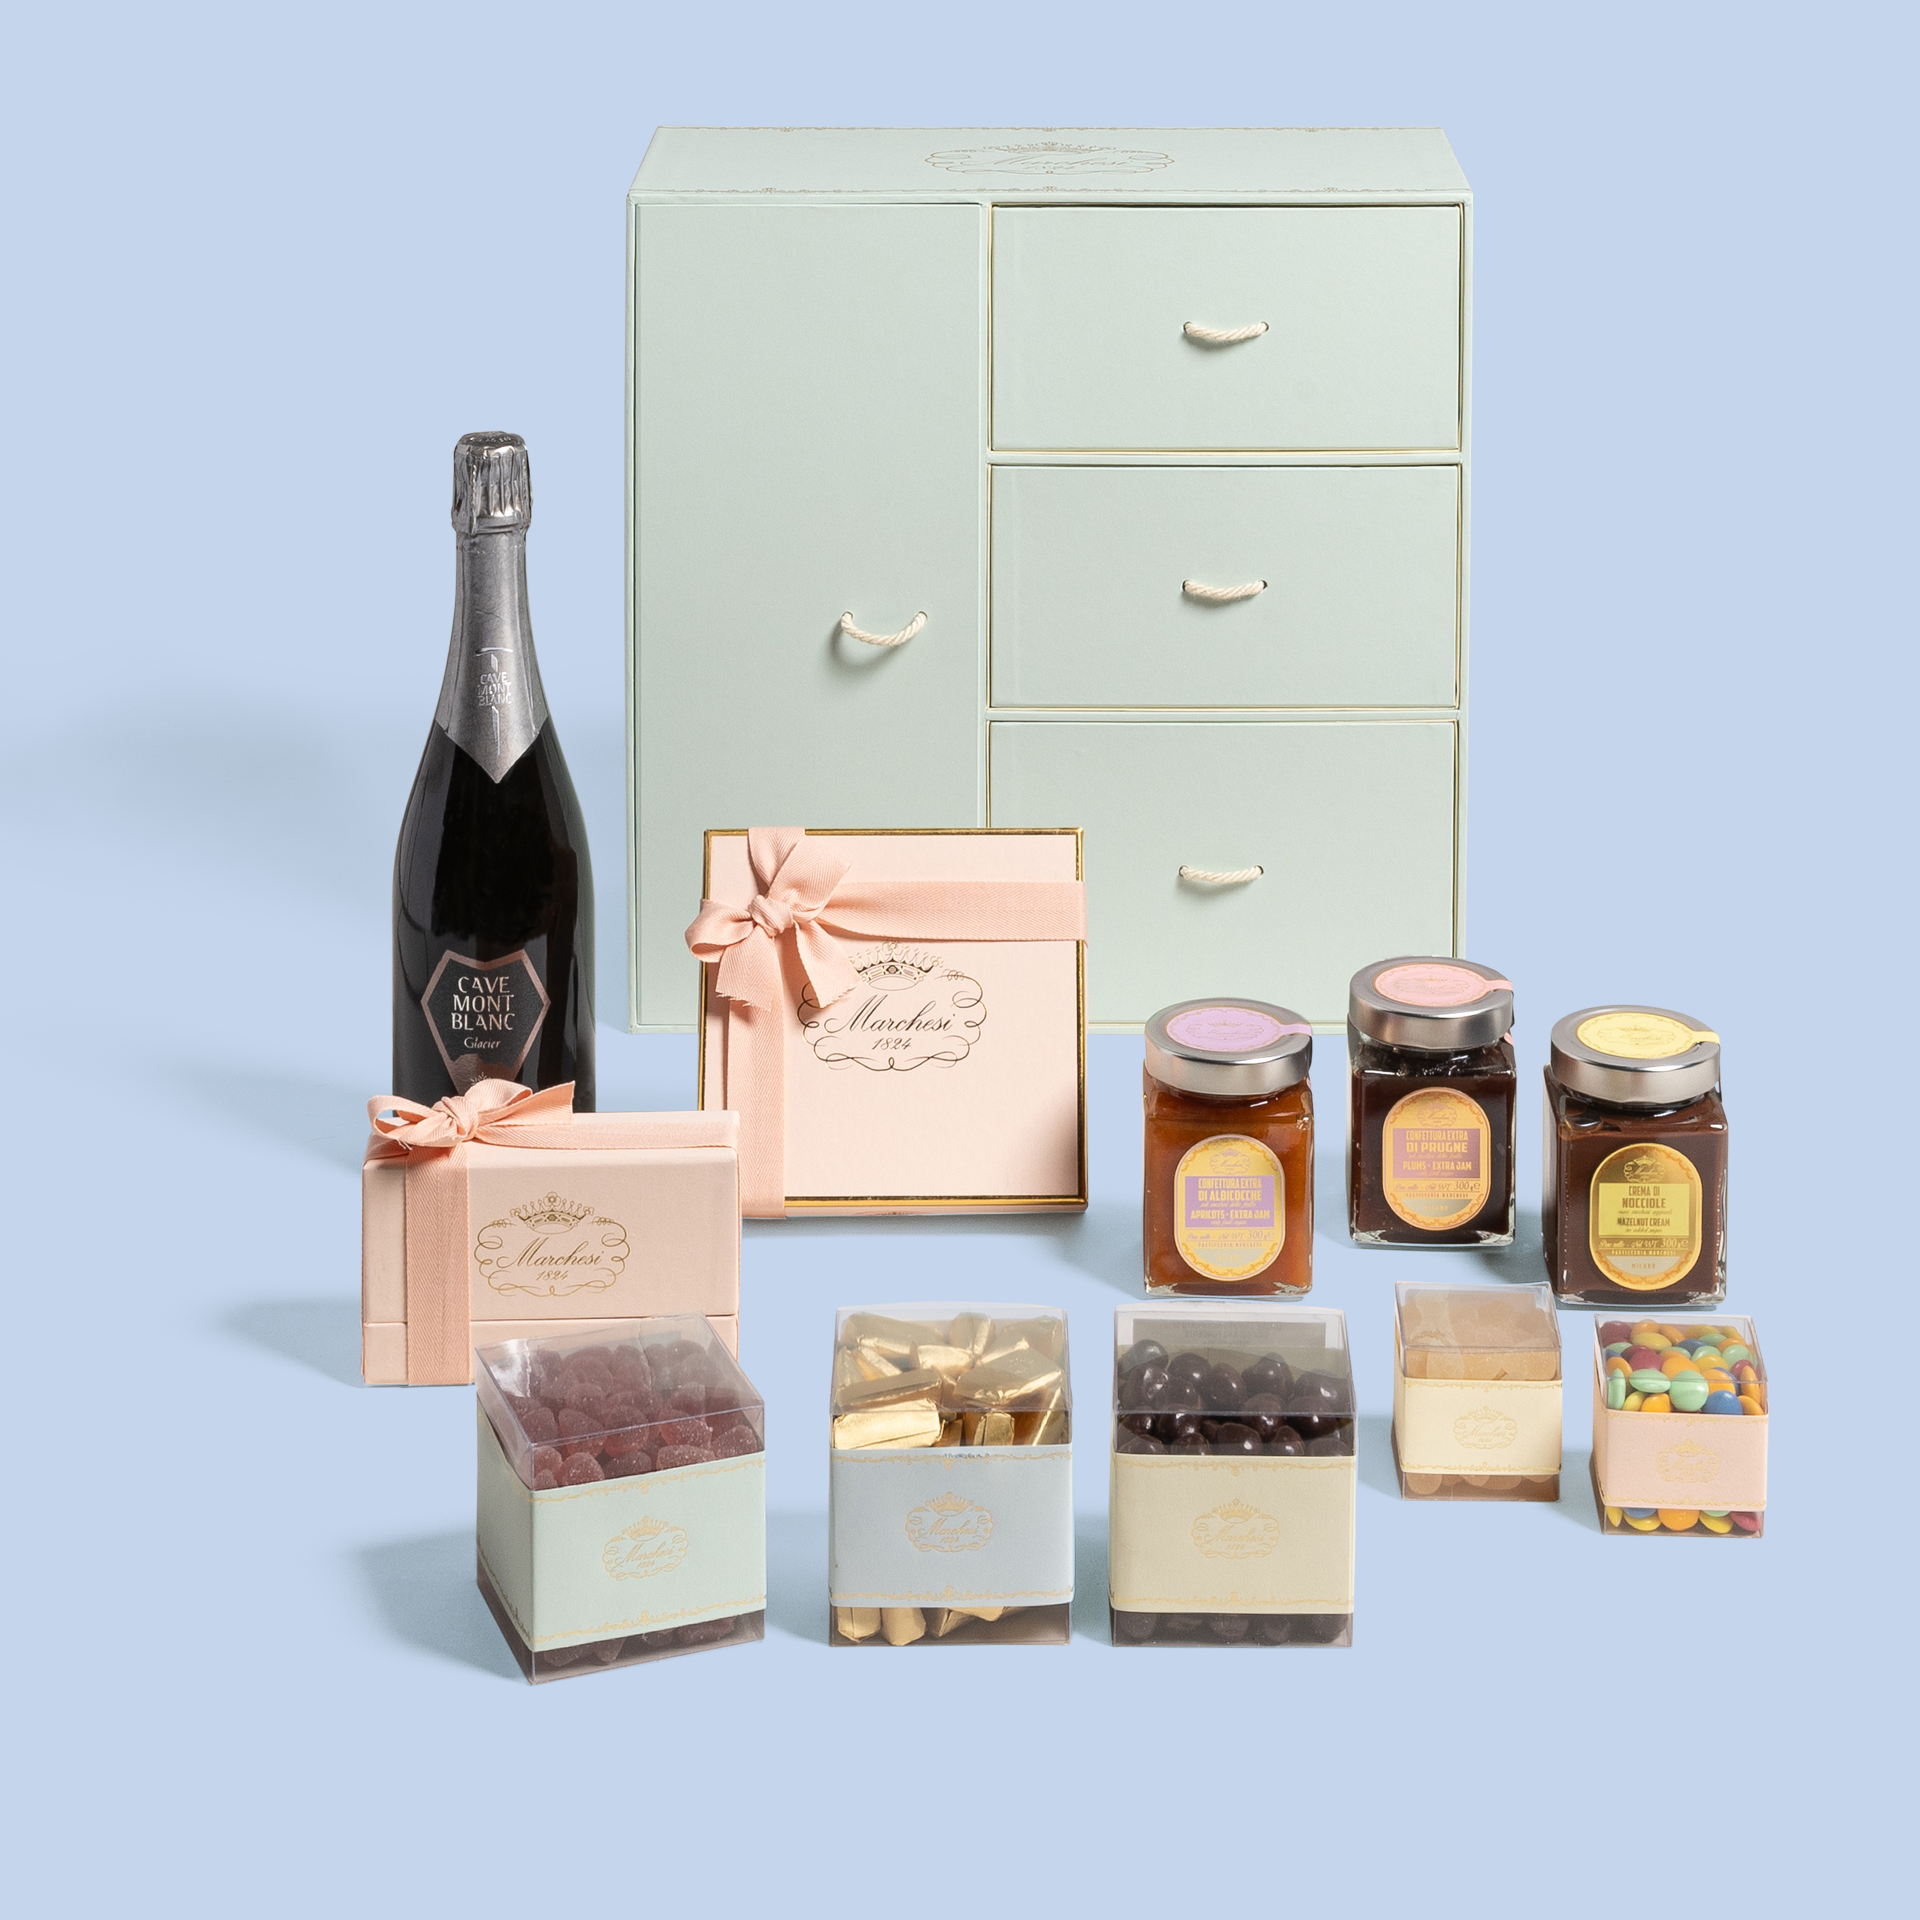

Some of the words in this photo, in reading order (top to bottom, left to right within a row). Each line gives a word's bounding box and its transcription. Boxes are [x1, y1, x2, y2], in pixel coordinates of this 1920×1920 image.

[480, 672, 508, 684] CAVE
[477, 682, 512, 695] MONT
[477, 694, 512, 706] BLANC
[458, 976, 510, 993] CAVE
[453, 994, 514, 1012] MONT
[824, 994, 956, 1033] Marchesi
[451, 1012, 515, 1031] BLANC
[464, 1037, 501, 1049] Glacier
[871, 1037, 912, 1050] 1824
[1406, 1130, 1446, 1141] CONFETTURA
[1447, 1130, 1468, 1141] EXTRA
[1406, 1142, 1417, 1152] DI
[1421, 1142, 1468, 1152] PRUGNE
[1403, 1161, 1426, 1170] PLUMS
[1432, 1161, 1455, 1170] EXTRA
[1456, 1161, 1472, 1170] JAM
[1198, 1178, 1240, 1188] CONFETTURA
[1241, 1178, 1262, 1188] EXTRA
[1198, 1190, 1207, 1201] DI
[1209, 1190, 1262, 1201] ALBICOCCHE
[1629, 1186, 1651, 1196] CREMA
[1653, 1186, 1660, 1196] DI
[1622, 1198, 1666, 1208] NOCCIOLE
[1191, 1210, 1225, 1219] APRICOTS
[1230, 1210, 1253, 1219] EXTRA
[1254, 1210, 1270, 1219] JAM
[1617, 1218, 1648, 1226] HAZELNUT
[1650, 1218, 1670, 1226] CREAM
[497, 1237, 604, 1268] Marchesi
[536, 1270, 569, 1281] 1824
